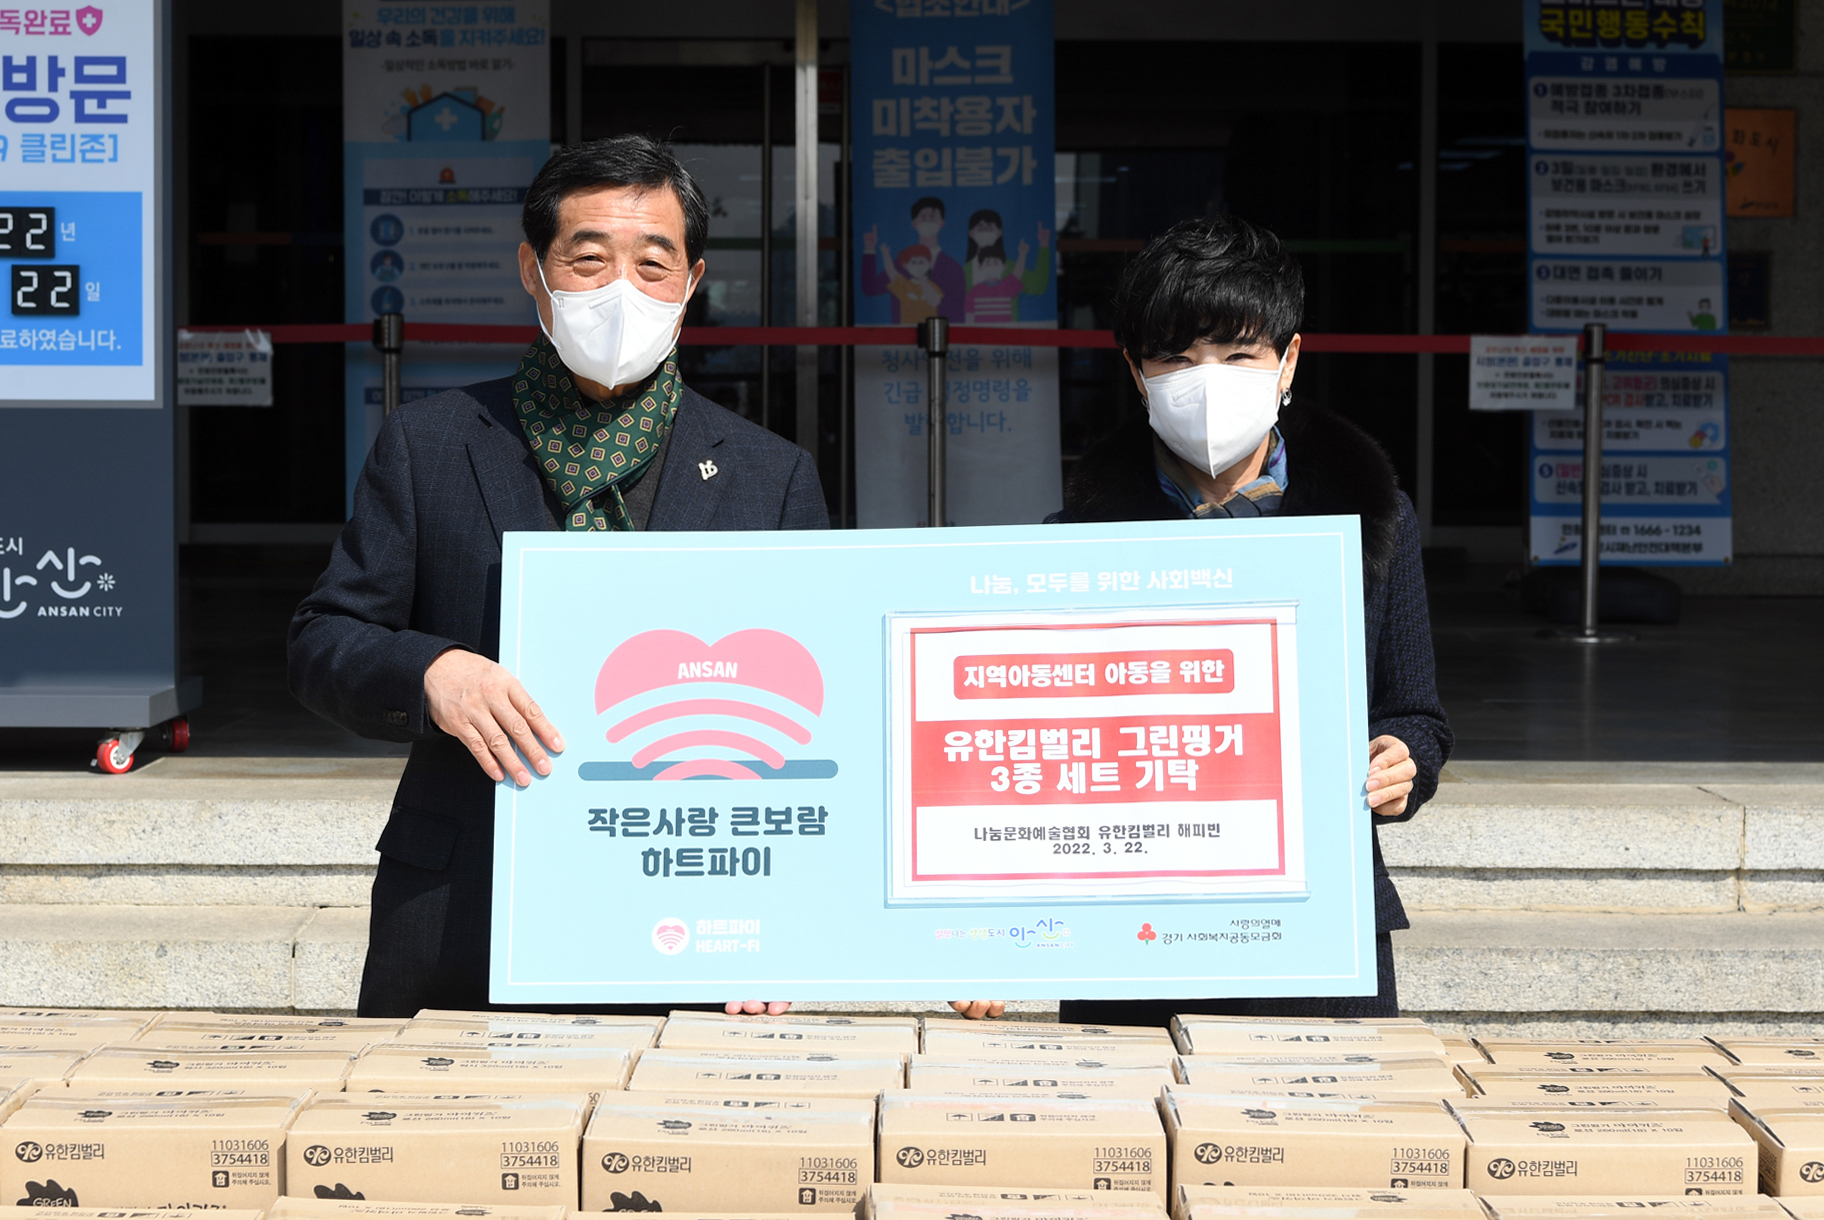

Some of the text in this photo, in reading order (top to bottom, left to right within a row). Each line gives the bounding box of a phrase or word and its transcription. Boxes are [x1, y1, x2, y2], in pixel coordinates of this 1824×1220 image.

[377, 7, 426, 25] 우리의
[483, 6, 515, 24] 위해
[1539, 8, 1706, 40] 국민행동수칙
[349, 29, 382, 48] 일상
[386, 29, 402, 47] 속
[459, 27, 546, 47] 지켜주세요!
[892, 45, 1014, 86] 마스크
[2, 55, 132, 124] 방문
[872, 95, 1037, 137] 미착용자
[20, 133, 118, 163] 클린존]
[872, 145, 1038, 189] 출입불가
[61, 222, 76, 242] 년
[1552, 265, 1662, 281] 대면 접촉 줄이기
[16, 270, 101, 308] 22 일
[991, 347, 1032, 371] 위해
[1522, 356, 1550, 367] 출입구
[883, 380, 923, 404] 긴급
[1705, 376, 1716, 391] 시
[1637, 464, 1648, 478] 시
[1634, 524, 1662, 537] 1666
[1673, 524, 1701, 537] 1234
[970, 567, 1234, 597] 나눔, 모두를 위한 사회백신
[37, 606, 123, 617] ANSAN CITY
[677, 661, 738, 680] ANSAN
[963, 658, 1225, 688] 지역아동센터 아동을 위한
[943, 724, 1244, 762] 유한킴벌리 그린핑거
[990, 758, 1199, 796] 3종 세트 기탁
[587, 804, 829, 838] 작은사랑 큰보람
[974, 822, 1221, 842] 나눔문화예술협회 유한킴벌리 해피빈
[1052, 842, 1149, 855] 2022. 3. 22.
[641, 846, 772, 878] 하트파이
[695, 918, 761, 935] 하트파이
[695, 939, 760, 953] HEART-FI
[1162, 932, 1282, 945] 경기 사회복지공동모금회
[45, 1143, 105, 1160] 유한킴벌리
[212, 1140, 269, 1151] 11031606
[502, 1141, 559, 1152] 11031606
[1095, 1147, 1152, 1158] 11031606
[1392, 1148, 1450, 1160] 11031606
[213, 1153, 268, 1165] 3754418
[333, 1146, 393, 1164] 유한킴벌리
[502, 1155, 558, 1167] 3754418
[800, 1157, 857, 1168] 11031606
[926, 1149, 986, 1166] 유한킴벌리
[1224, 1146, 1284, 1164] 유한킴벌리
[1686, 1157, 1743, 1168] 11031606
[632, 1155, 692, 1173] 유한킴벌리
[1095, 1160, 1151, 1173] 3754418
[1393, 1161, 1448, 1174] 3754418
[1517, 1160, 1578, 1177] 유한킴벌리
[800, 1171, 856, 1183] 3754418
[1687, 1170, 1742, 1182] 3754418
